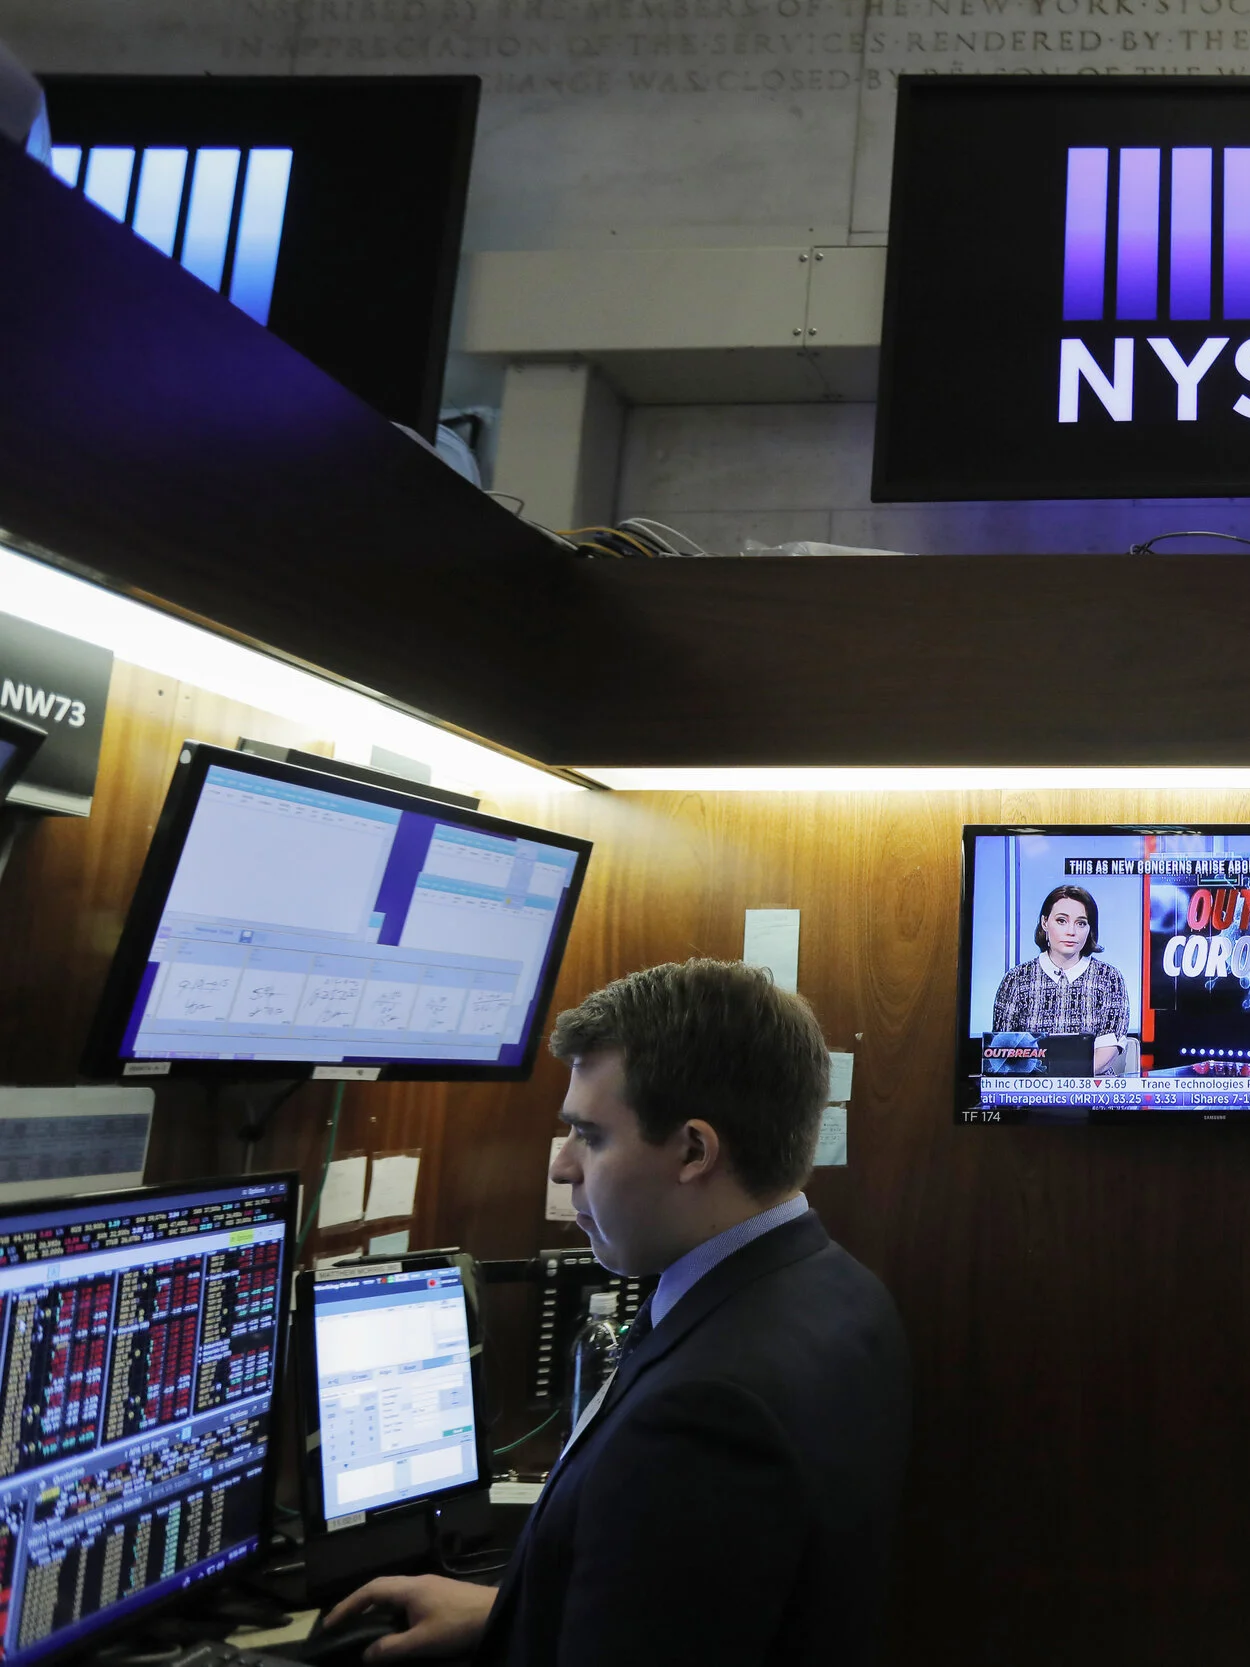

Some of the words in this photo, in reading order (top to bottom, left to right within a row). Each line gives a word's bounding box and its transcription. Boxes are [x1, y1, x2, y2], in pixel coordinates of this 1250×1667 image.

[926, 0, 1008, 16] NEW
[1027, 0, 1135, 16] YORK
[710, 31, 886, 55] SERVICES
[906, 30, 1102, 53] RENDERED
[1122, 29, 1160, 52] BY
[1178, 29, 1250, 52] THE
[717, 69, 850, 92] CLOSED
[1, 679, 86, 728] NW73
[1069, 860, 1093, 875] THIS
[1095, 860, 1108, 875] AS
[1112, 860, 1135, 875] NEW
[1195, 860, 1225, 875] ARISE
[984, 1049, 1047, 1058] OUTBREAK
[995, 1079, 1010, 1089] Inc
[1014, 1079, 1053, 1089] (TDOC)
[1057, 1079, 1091, 1089] 140.38
[1105, 1079, 1127, 1089] 5.69
[1141, 1079, 1170, 1089] Trane
[1175, 1079, 1244, 1091] Technologies
[981, 1094, 996, 1104] ati
[999, 1094, 1067, 1105] Therapeutics
[1070, 1094, 1110, 1105] (MRTX)
[1113, 1094, 1141, 1104] 83.25
[1154, 1094, 1177, 1104] 3.33
[962, 1112, 978, 1122] TF
[982, 1112, 1001, 1122] 174
